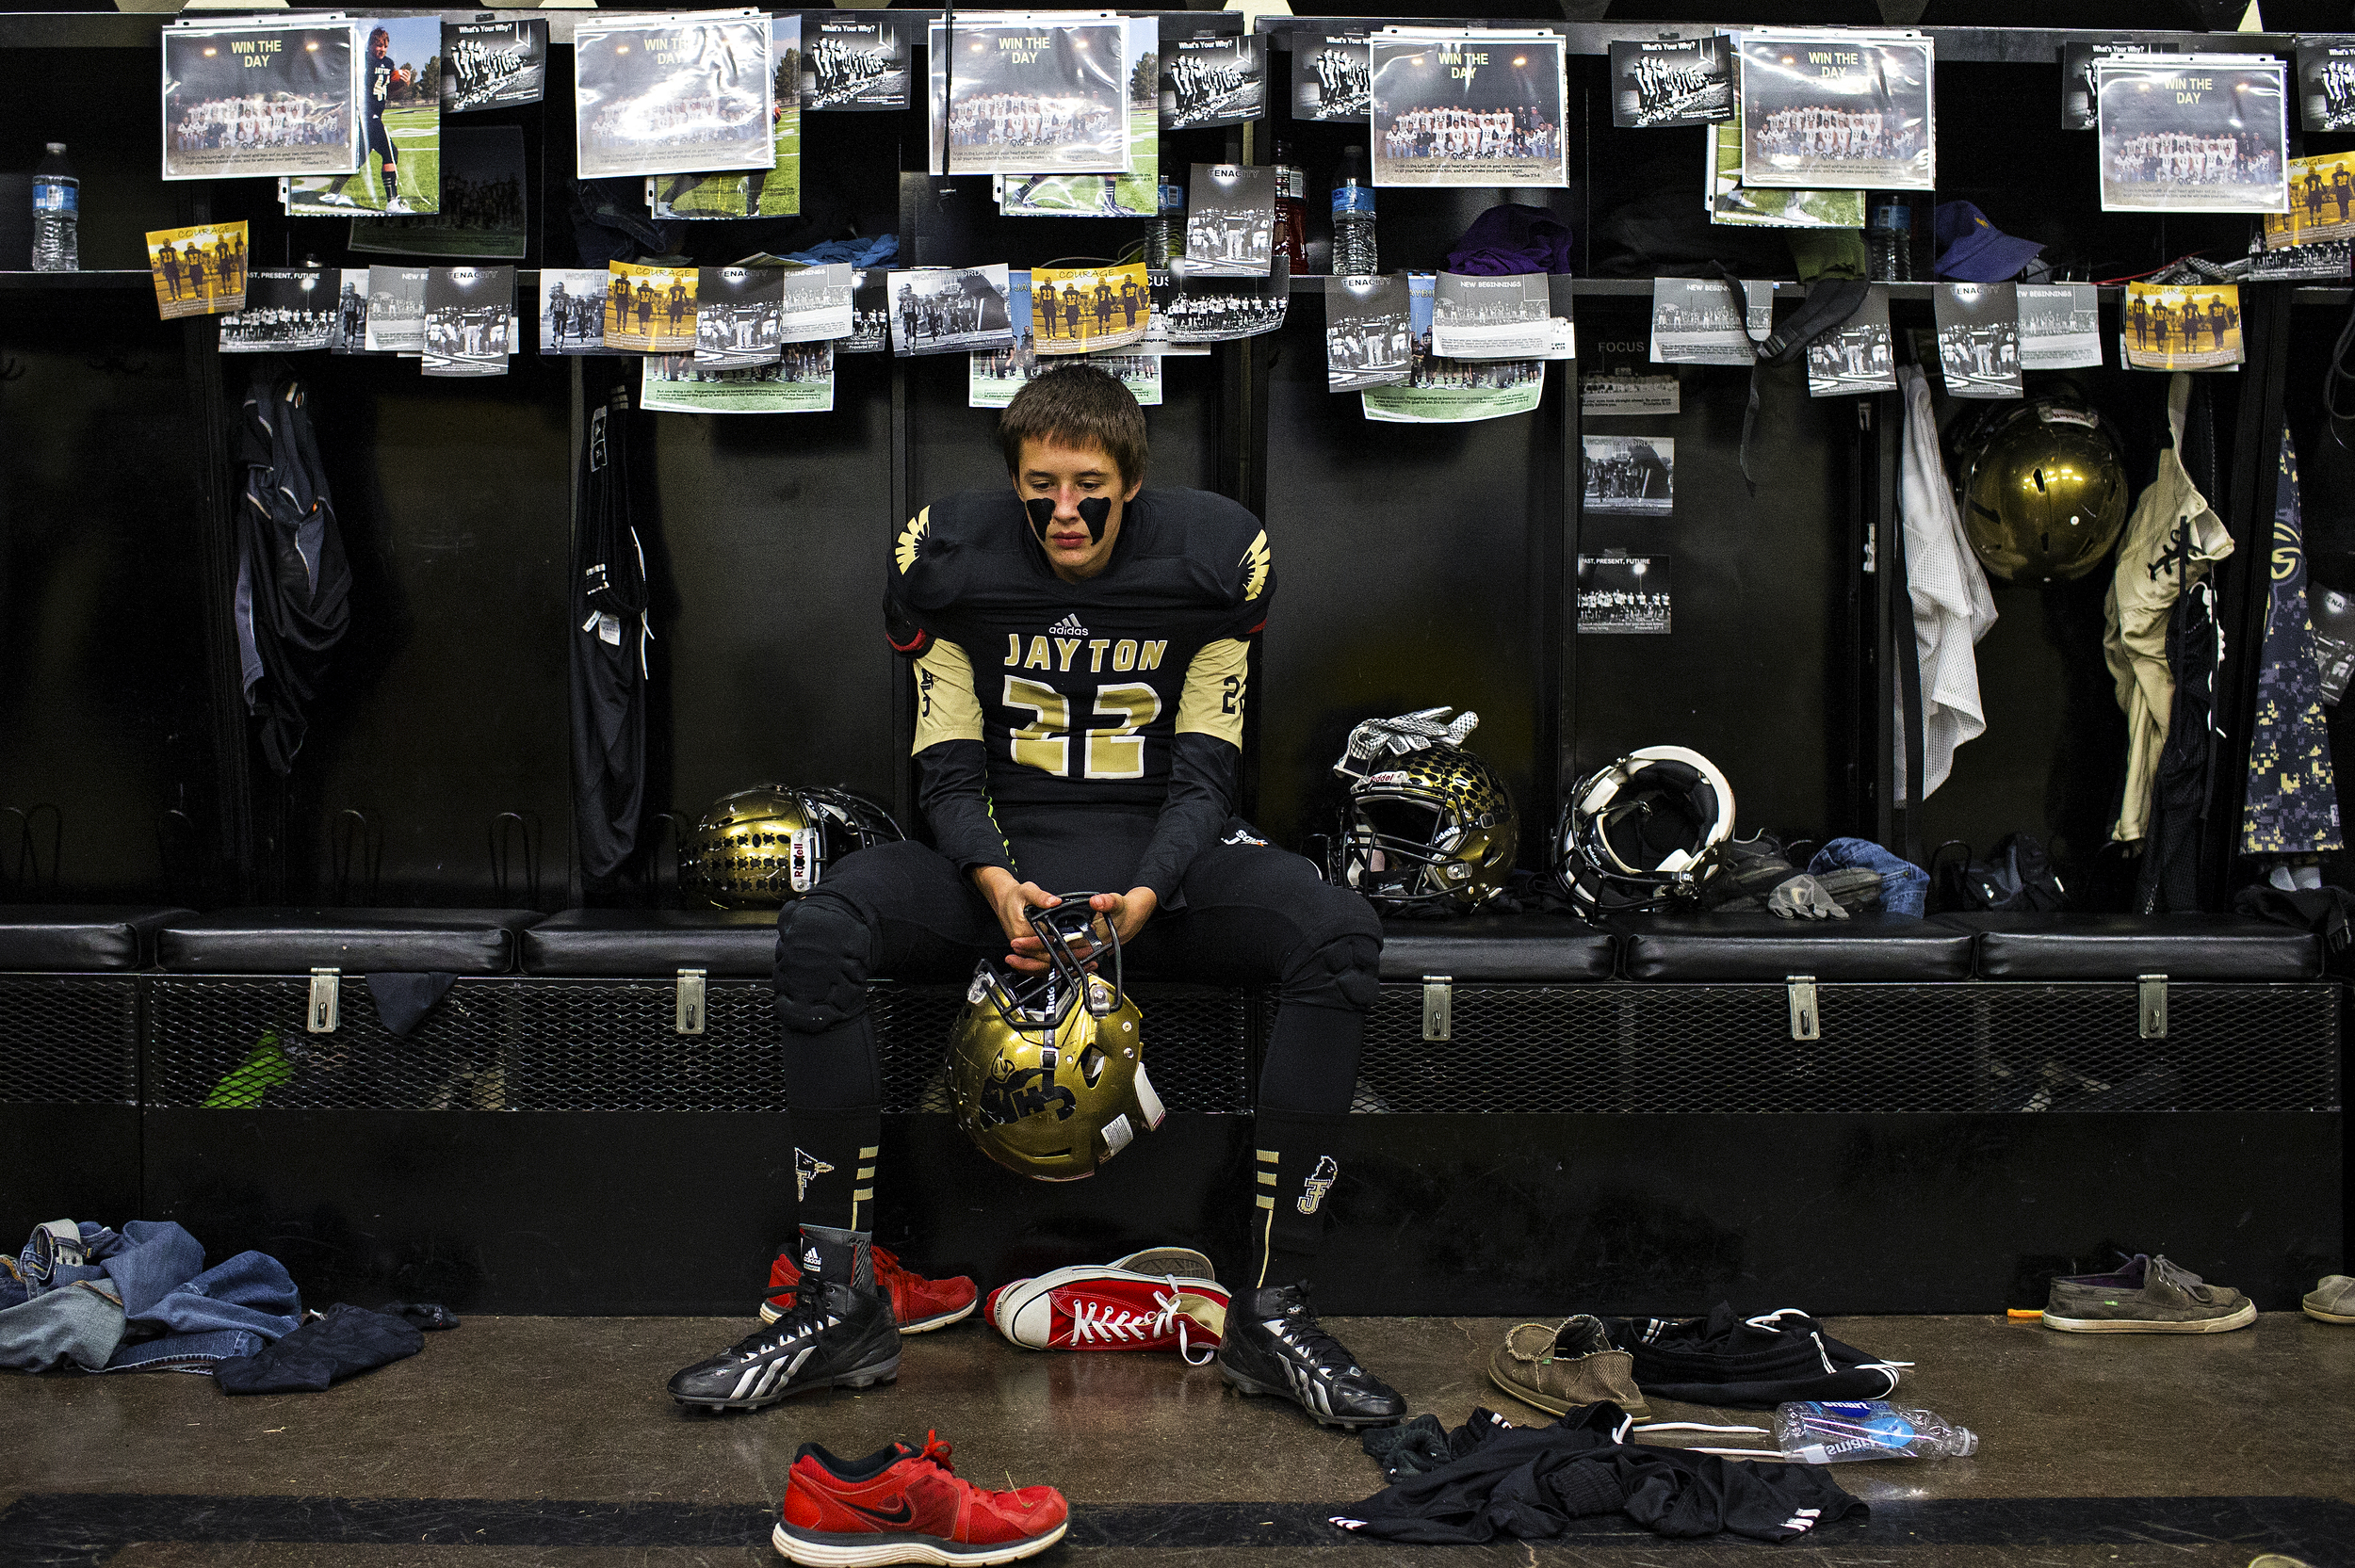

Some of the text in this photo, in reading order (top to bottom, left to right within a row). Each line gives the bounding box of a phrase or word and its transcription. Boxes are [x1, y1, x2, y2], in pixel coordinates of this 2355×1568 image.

[495, 24, 513, 32] Why?
[821, 25, 841, 33] What's
[858, 25, 876, 33] Why?
[232, 40, 282, 53] WIN THE
[644, 37, 690, 51] WIN TH
[999, 37, 1050, 49] WIN THE
[1678, 41, 1696, 50] Why?
[244, 56, 270, 68] DAY
[658, 53, 682, 65] DAY
[1012, 52, 1038, 64] DAY
[1438, 53, 1488, 65] WIN THE
[1808, 52, 1858, 65] WIN THE
[1451, 67, 1477, 79] DAY
[1822, 66, 1847, 78] DAY
[2165, 78, 2212, 90] WIN THE
[2177, 92, 2201, 104] DAY
[1208, 169, 1260, 178] TENACITY
[178, 225, 230, 239] COURAGE
[448, 271, 498, 279] TENACITY
[635, 267, 691, 278] COURAGE
[953, 270, 986, 278] WORDS
[1059, 269, 1115, 280] COURAGE
[1341, 277, 1392, 288] TENACITY
[1950, 286, 2000, 295] TENACITY
[2149, 286, 2201, 296] COURAGE
[1598, 341, 1644, 353] FOCUS
[1049, 626, 1089, 635] adidas
[1004, 633, 1168, 673] JAYTON
[1222, 675, 1245, 715] 2
[1002, 675, 1162, 779] 22
[794, 844, 803, 877] Riell
[1586, 844, 1601, 867] Riddell
[803, 1257, 822, 1266] adidas
